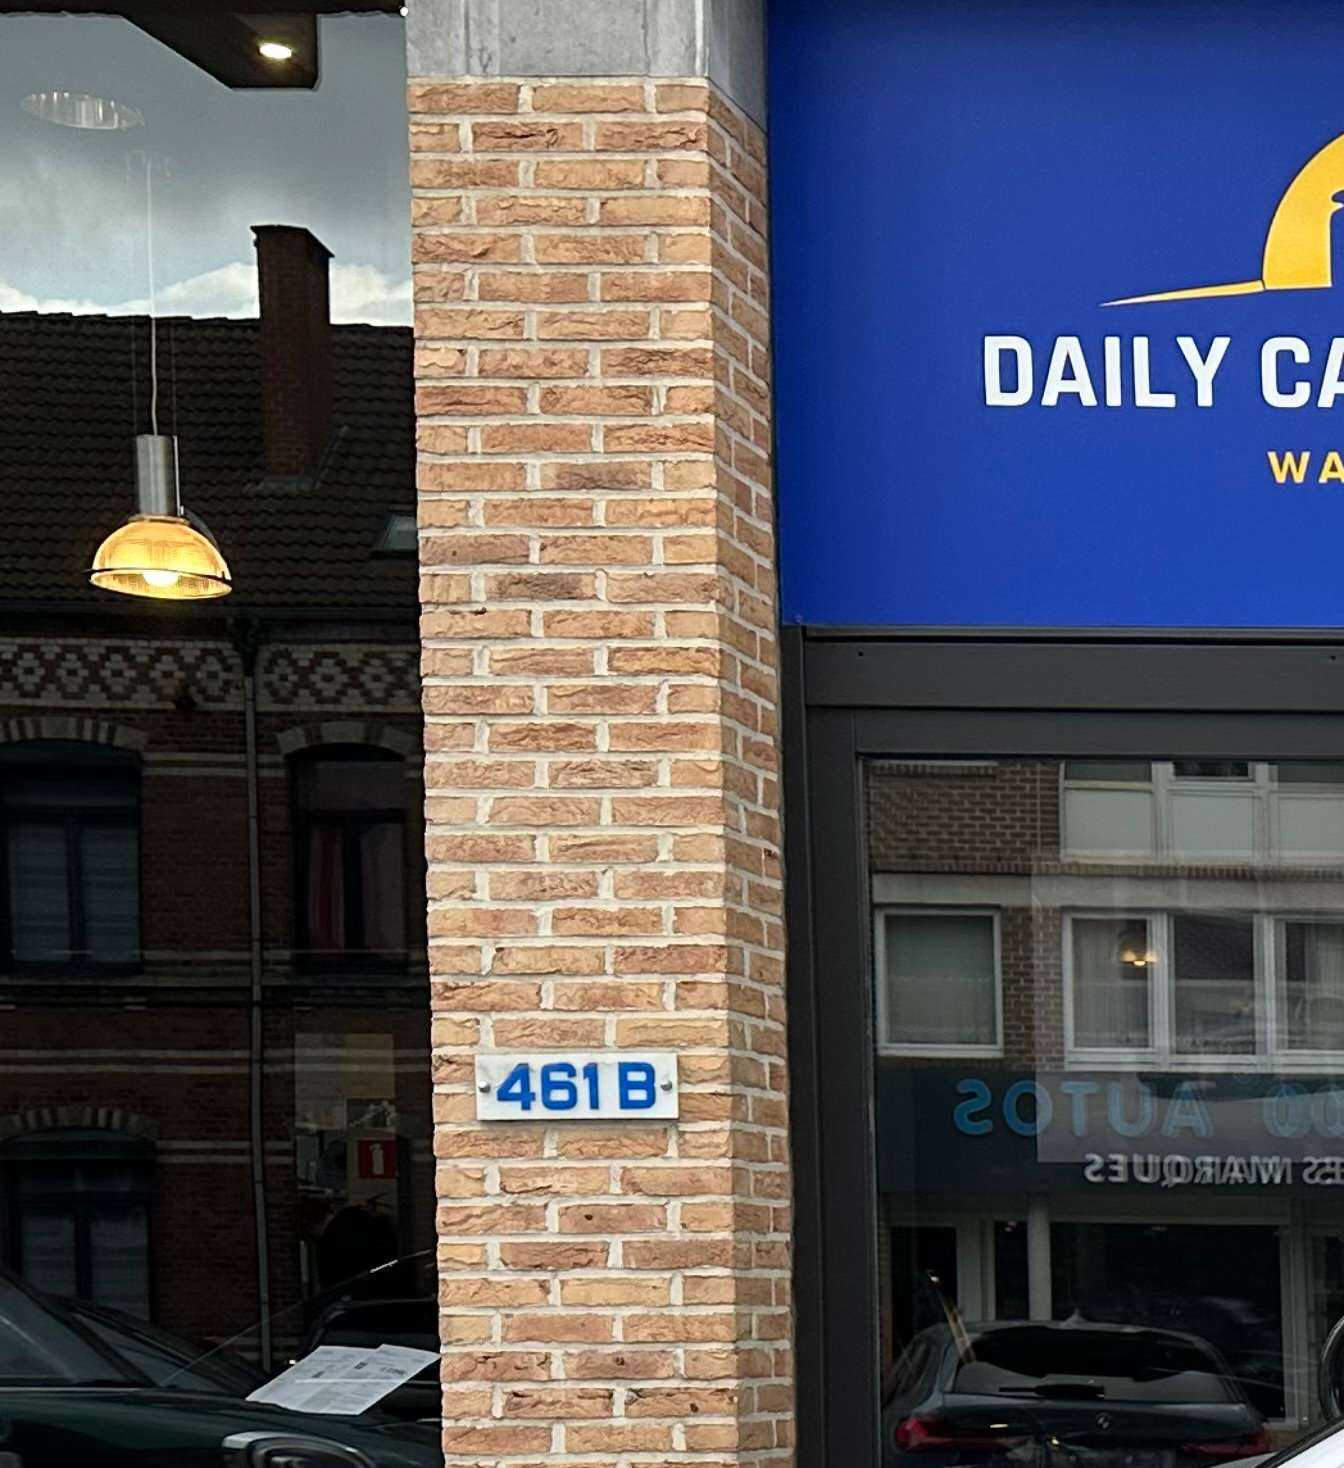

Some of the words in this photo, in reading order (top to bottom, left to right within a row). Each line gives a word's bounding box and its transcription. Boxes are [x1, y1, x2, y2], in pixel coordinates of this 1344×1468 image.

[983, 334, 1232, 408] DAILY
[496, 1062, 600, 1111] 461
[617, 1061, 656, 1110] B
